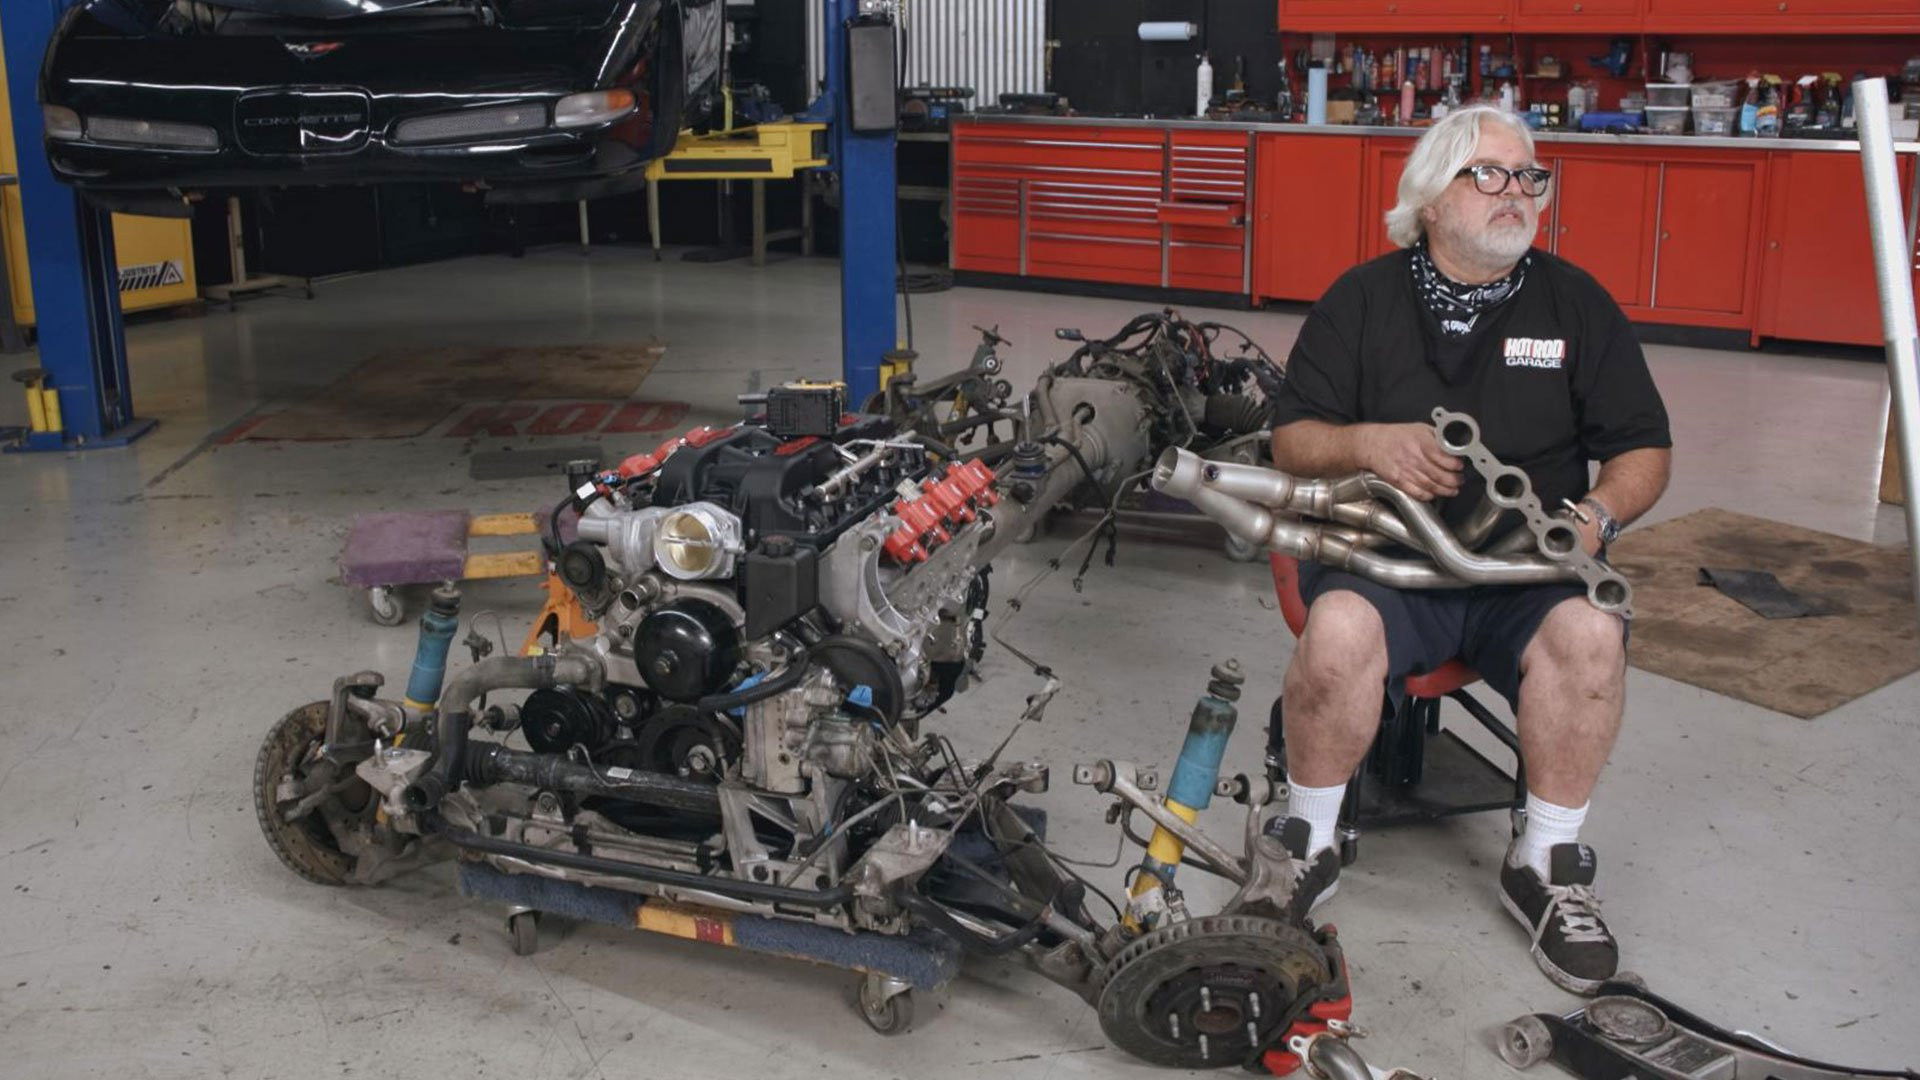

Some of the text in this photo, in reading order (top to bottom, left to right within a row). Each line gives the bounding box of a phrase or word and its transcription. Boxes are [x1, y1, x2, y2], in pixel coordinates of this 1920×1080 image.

[243, 114, 361, 126] CORVETTE
[1504, 338, 1564, 358] HOT ROD
[1506, 358, 1561, 369] GARAGE
[443, 402, 691, 436] ROD
